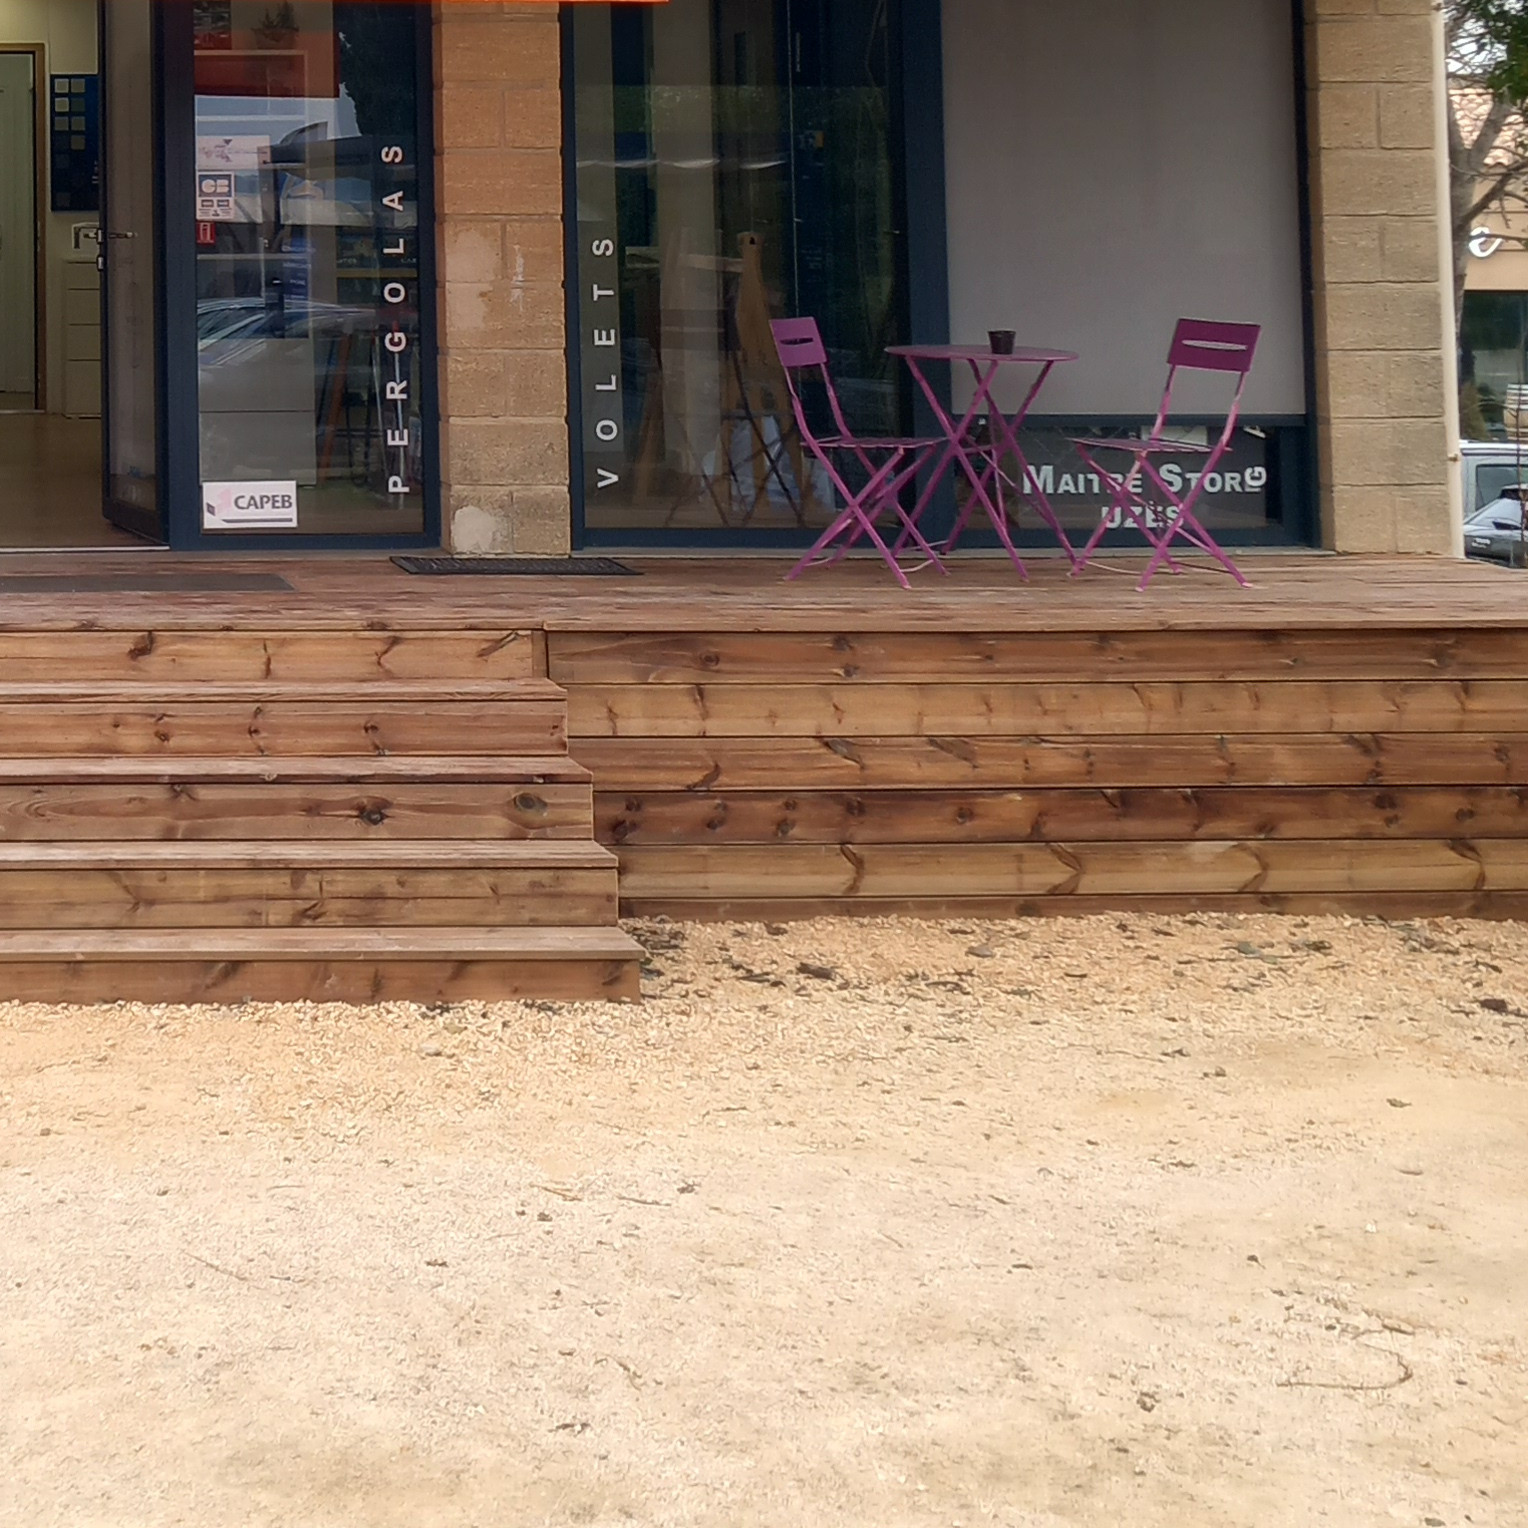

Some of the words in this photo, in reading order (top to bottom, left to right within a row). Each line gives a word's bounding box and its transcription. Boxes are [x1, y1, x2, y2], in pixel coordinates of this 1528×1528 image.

[382, 144, 410, 493] PERGOLAS
[592, 239, 618, 487] VOLETS
[234, 494, 293, 510] CAPEB
